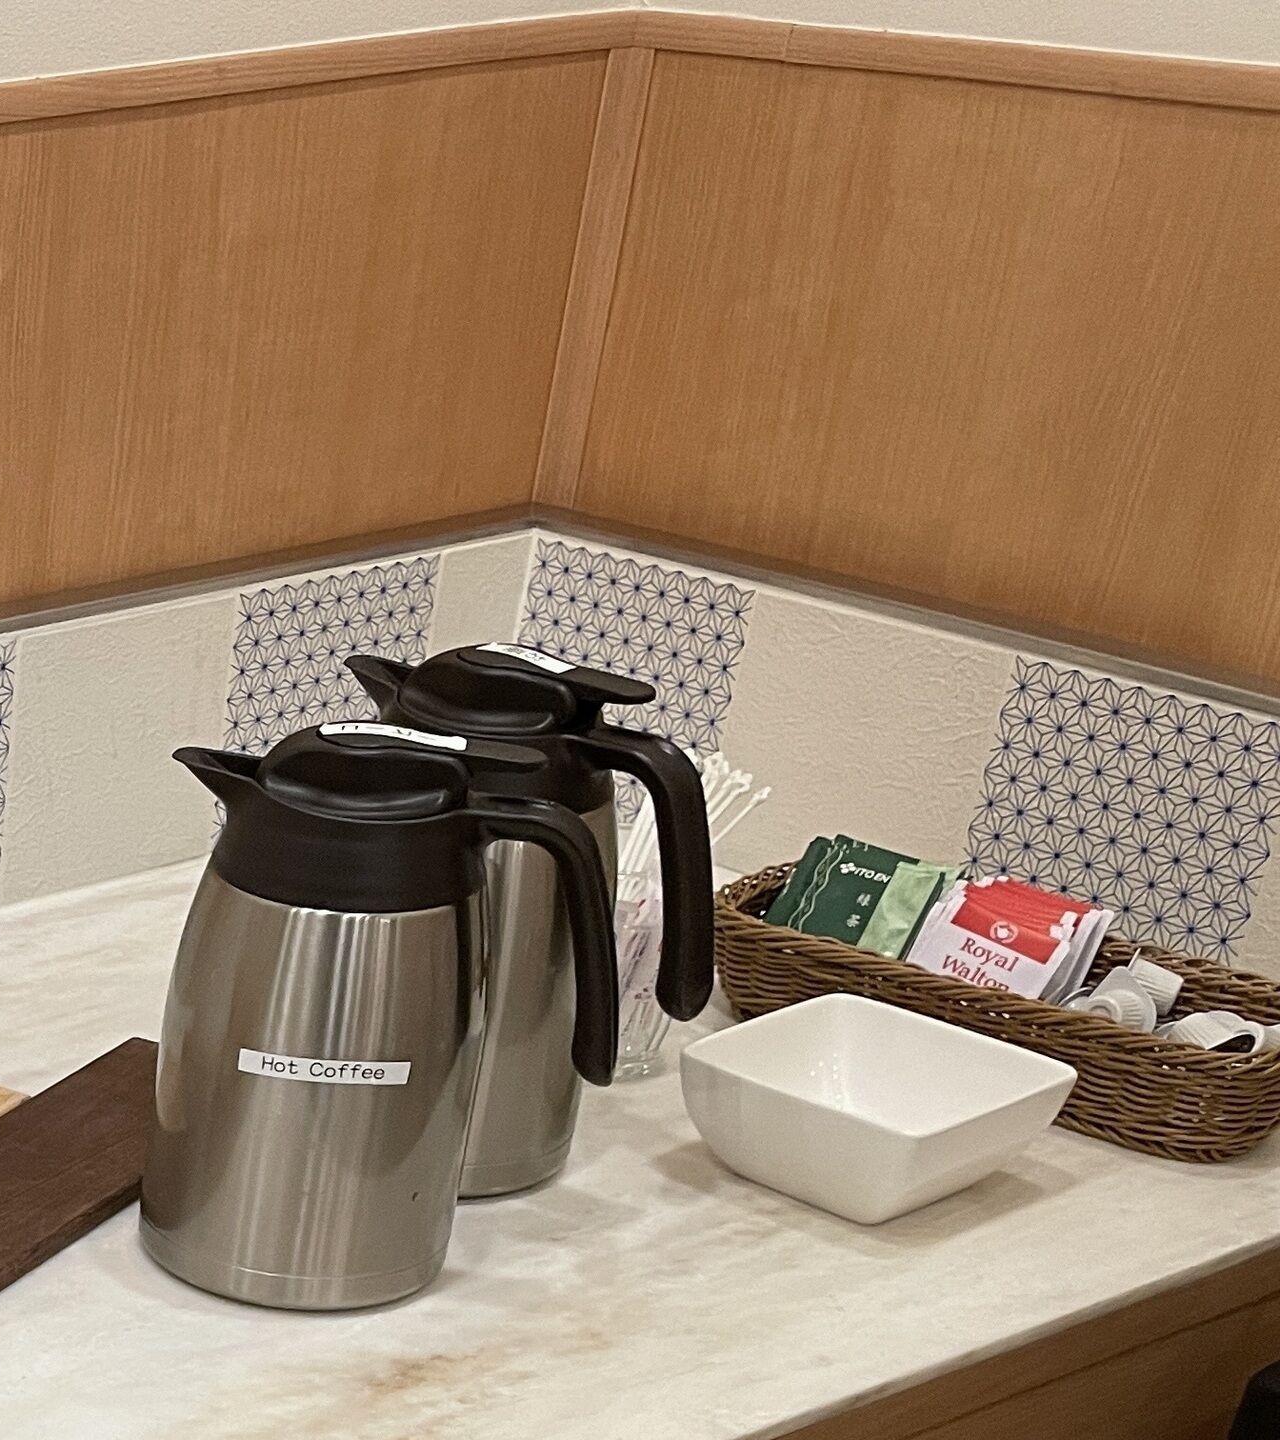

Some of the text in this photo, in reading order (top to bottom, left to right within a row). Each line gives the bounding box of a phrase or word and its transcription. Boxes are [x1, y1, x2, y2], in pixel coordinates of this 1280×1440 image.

[960, 937, 1019, 972] Royal
[261, 1056, 385, 1080] Hot Coffee
